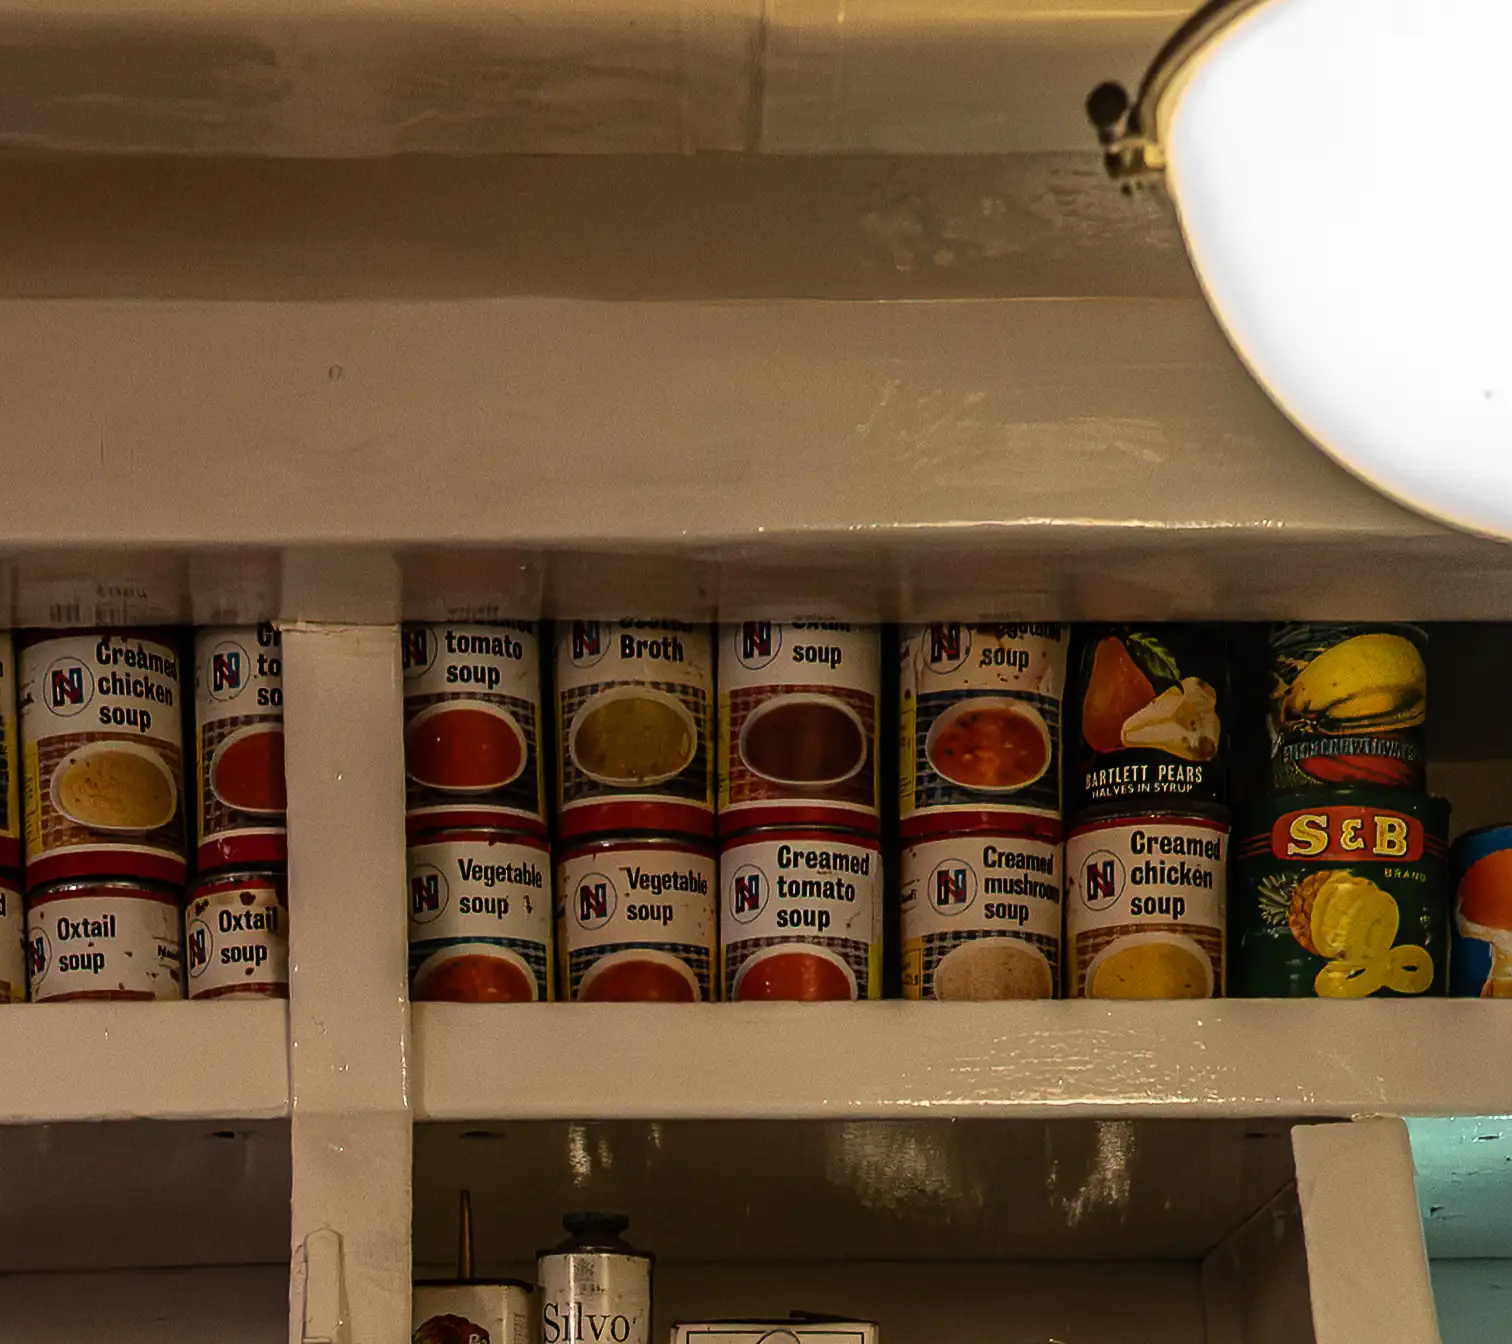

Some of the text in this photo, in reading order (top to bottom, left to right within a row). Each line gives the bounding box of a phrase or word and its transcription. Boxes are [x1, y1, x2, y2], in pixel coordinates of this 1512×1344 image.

[1085, 765, 1204, 789] BARTLETT PEARS
[1130, 830, 1220, 861] Creamed
[1130, 861, 1213, 890] chicken
[1130, 892, 1185, 918] soup
